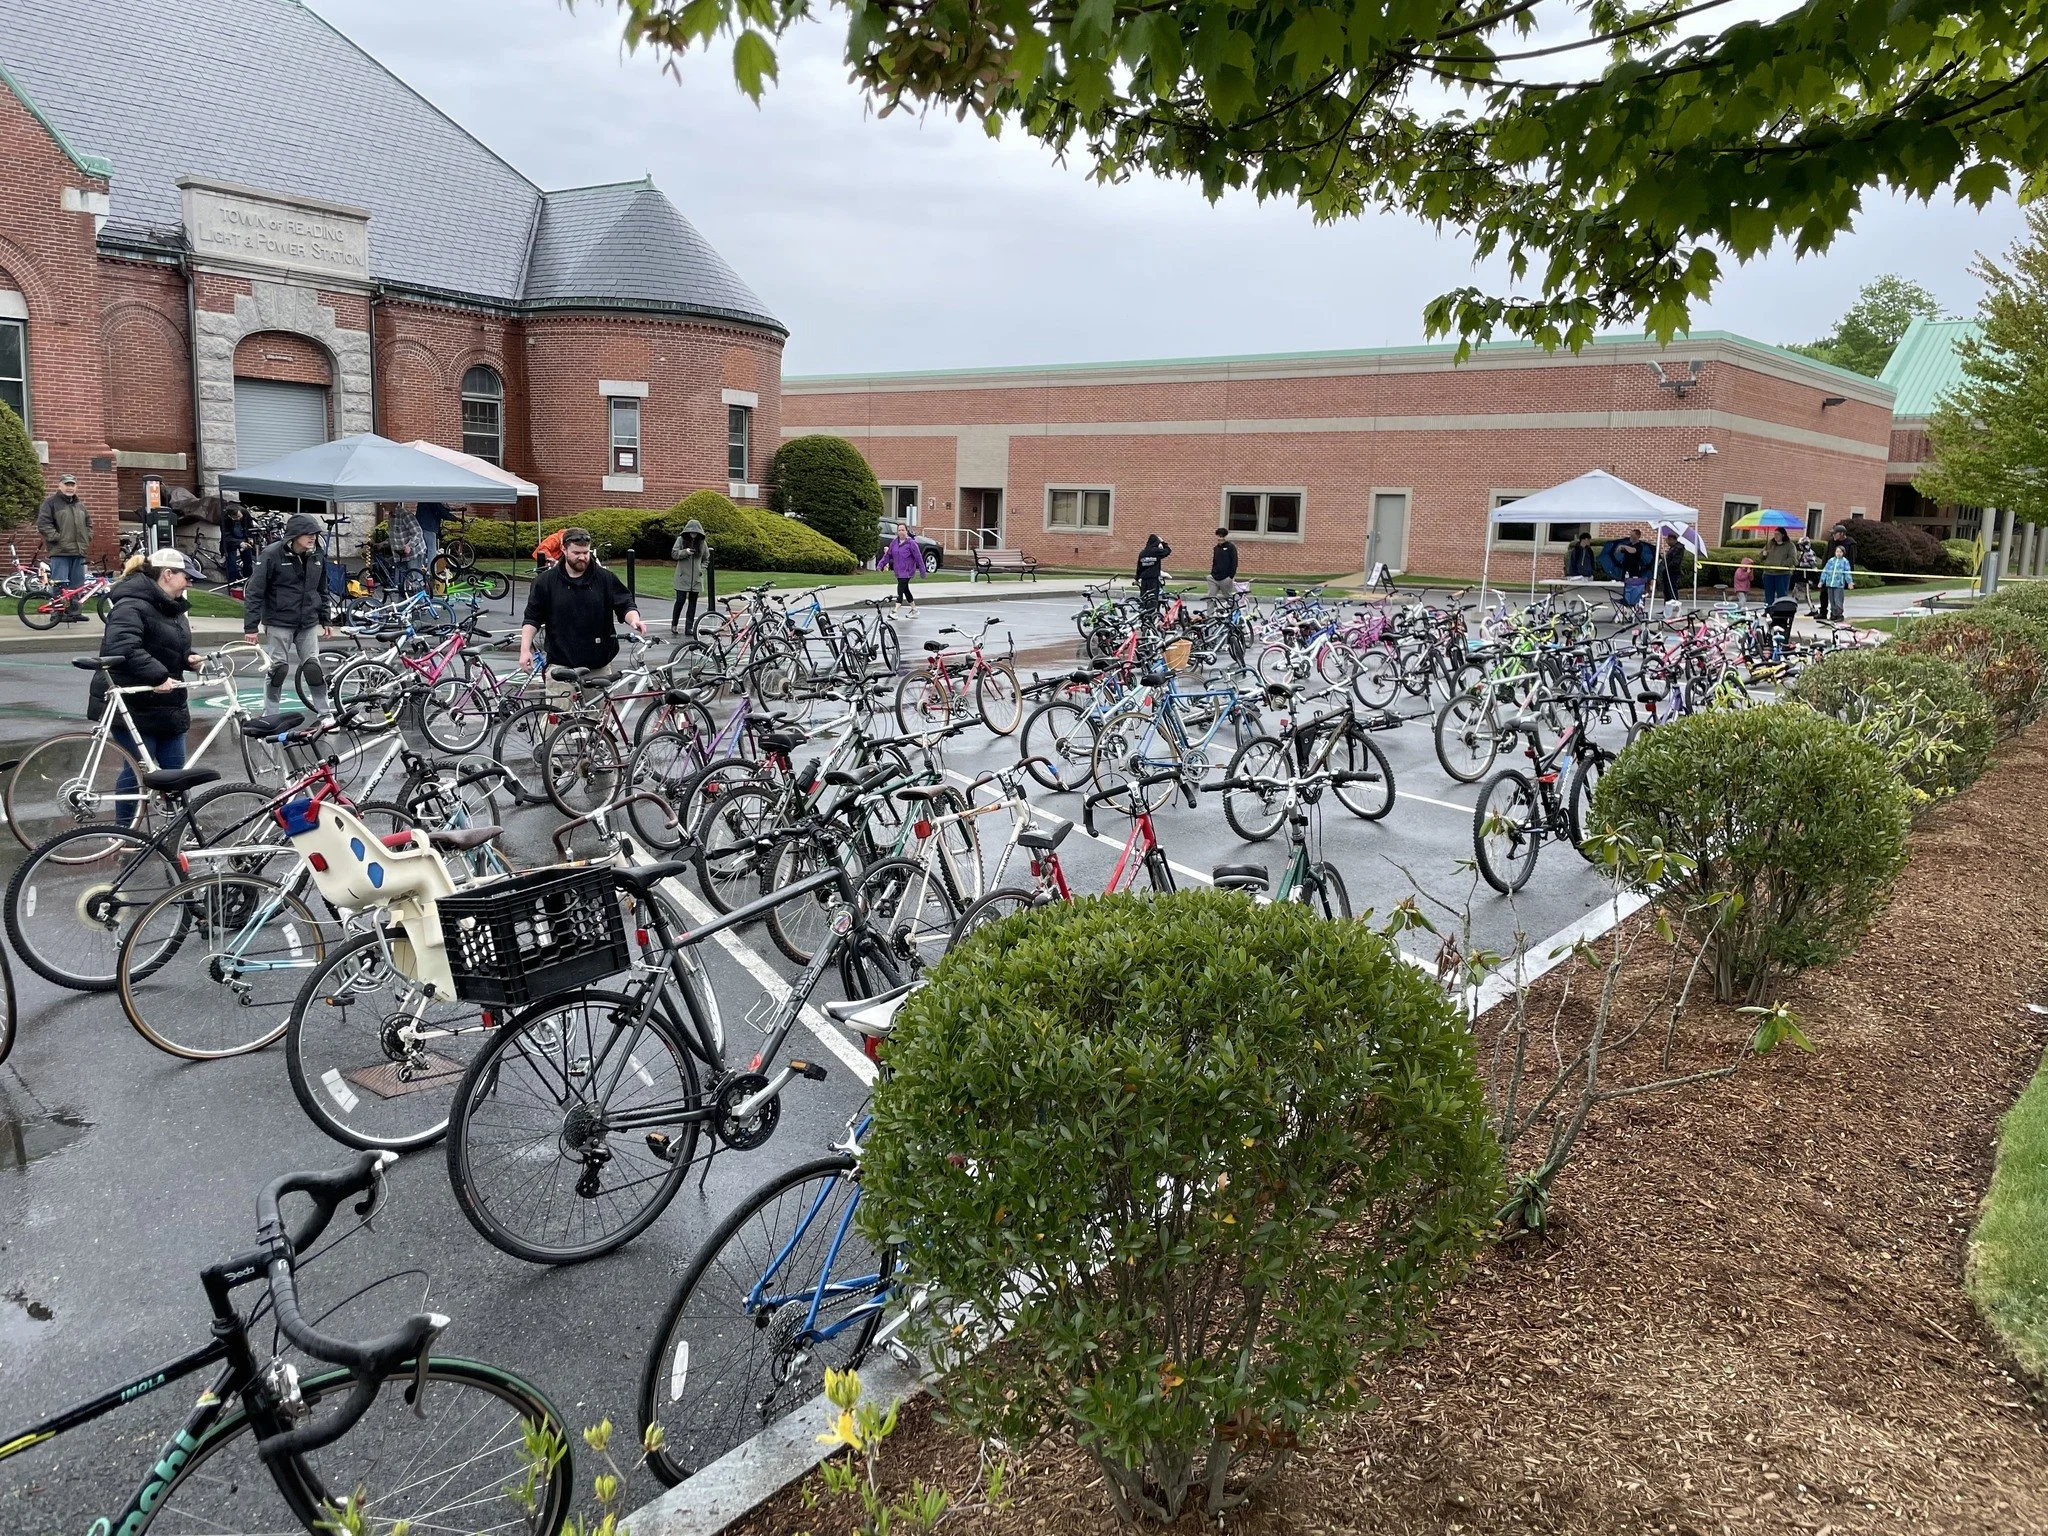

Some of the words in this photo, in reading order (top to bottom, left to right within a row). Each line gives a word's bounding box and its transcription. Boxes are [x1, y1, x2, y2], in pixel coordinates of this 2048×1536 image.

[198, 221, 241, 247] LIGHT
[243, 236, 254, 249] &
[256, 232, 306, 258] POWER
[219, 208, 266, 229] TOWN
[269, 220, 284, 231] OF
[285, 219, 344, 243] READING
[781, 949, 831, 1031] GLOBE
[121, 1373, 166, 1401] IMOLA
